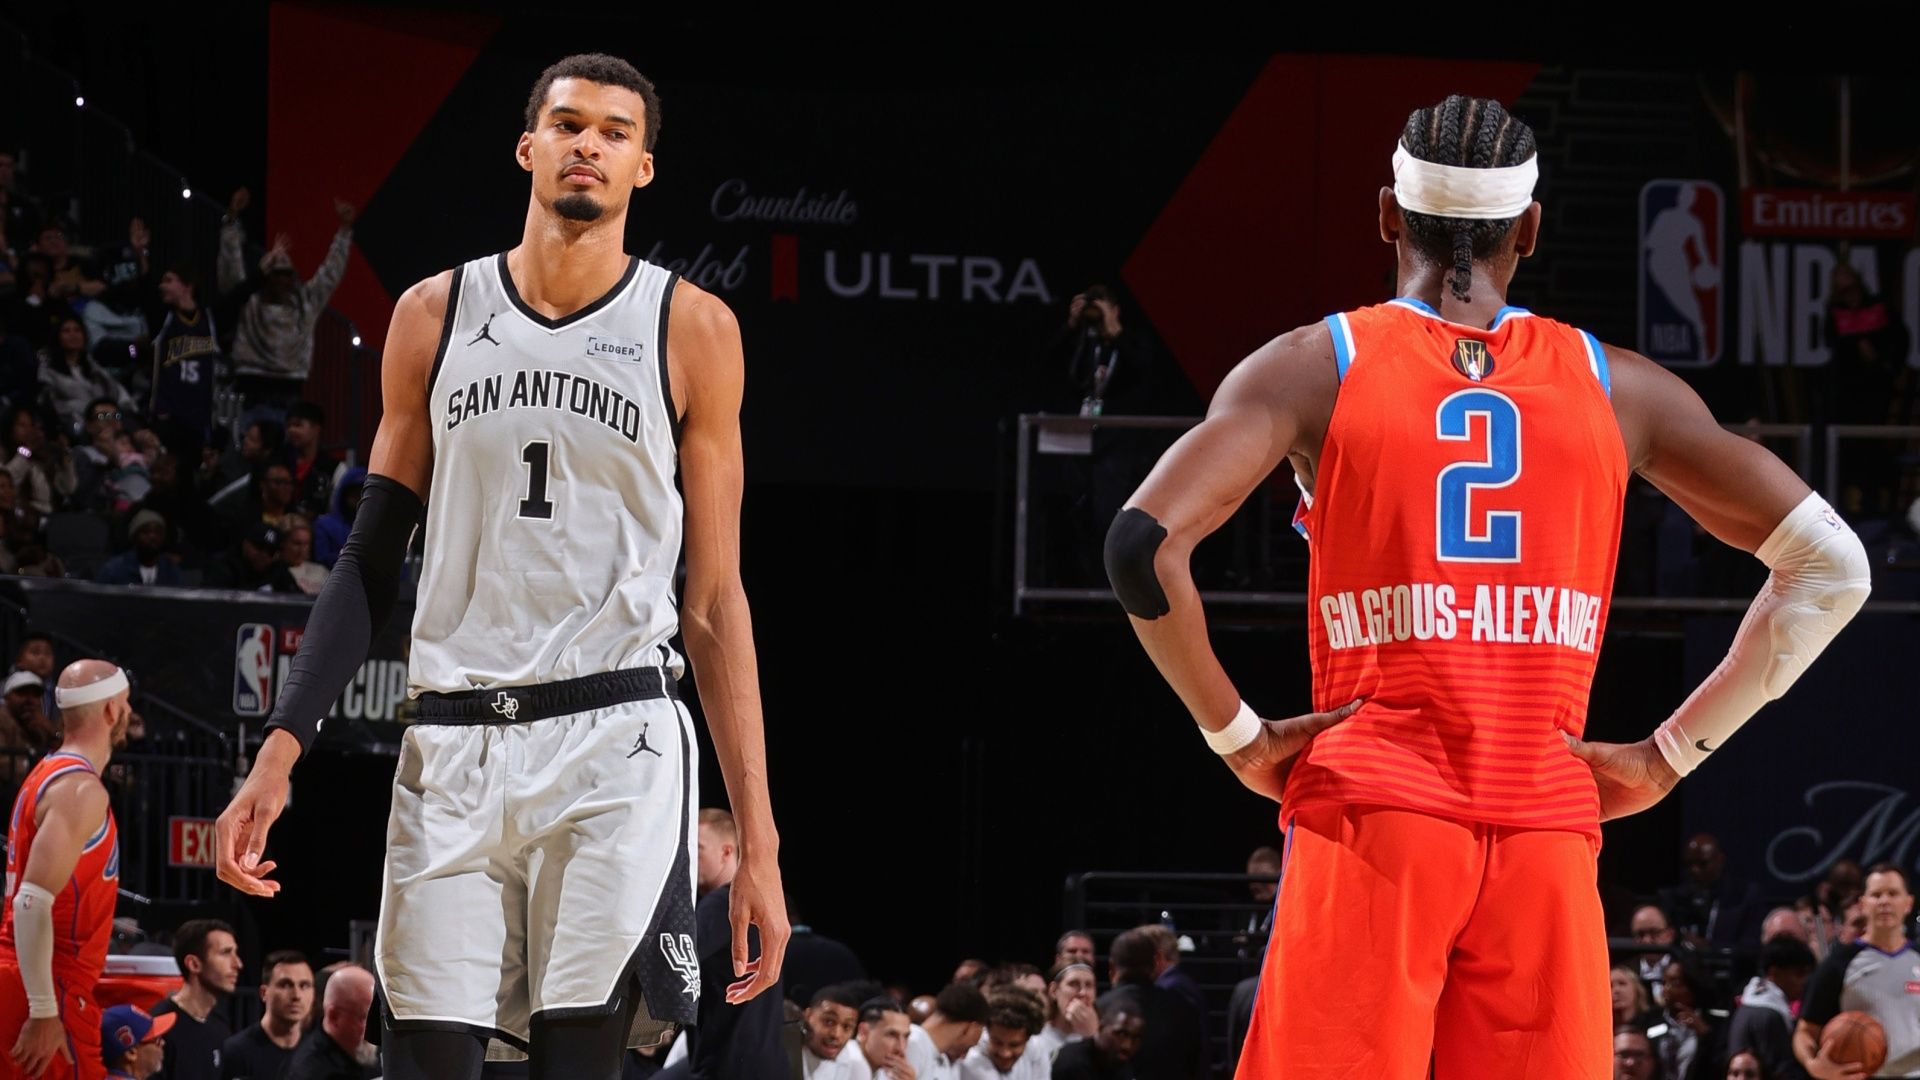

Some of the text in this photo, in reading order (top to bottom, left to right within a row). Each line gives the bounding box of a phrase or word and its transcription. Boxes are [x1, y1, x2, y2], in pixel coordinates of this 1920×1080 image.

[709, 178, 858, 225] Courtside
[1751, 193, 1906, 230] Emirates
[646, 240, 1052, 305] helob ULTRA
[594, 342, 636, 357] LEDGER
[1651, 322, 1691, 352] NBA
[180, 360, 200, 384] 15
[447, 369, 641, 445] SAN ANTONIO
[517, 440, 555, 521] 1
[1435, 387, 1522, 564] 2
[342, 659, 408, 721] CUP
[181, 822, 216, 864] EXI
